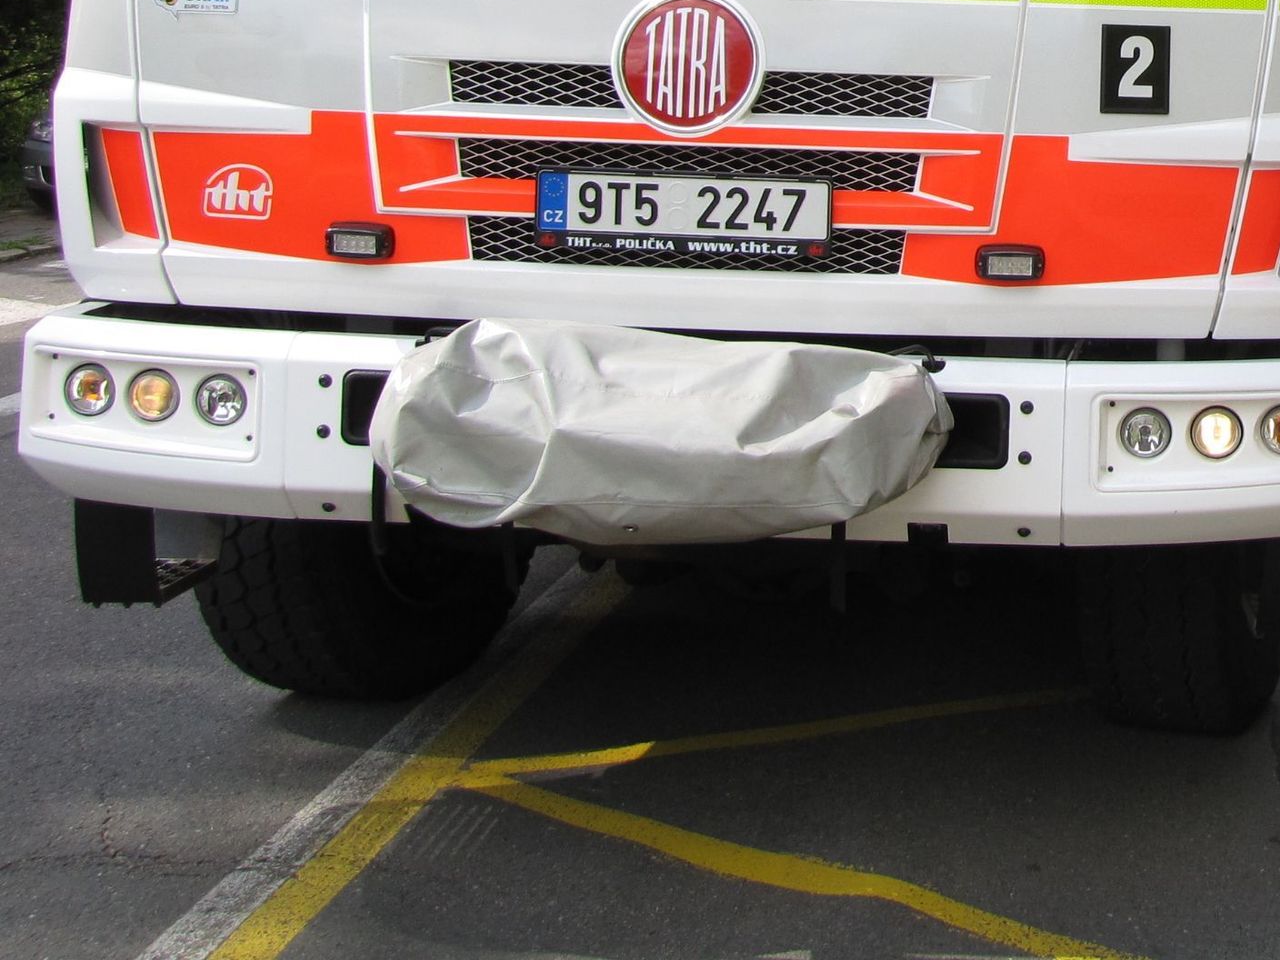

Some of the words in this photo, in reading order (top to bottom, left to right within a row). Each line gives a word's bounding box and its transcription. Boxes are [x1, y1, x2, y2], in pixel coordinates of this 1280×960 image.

[645, 6, 727, 119] TATRA
[1117, 34, 1155, 98] 2
[205, 170, 271, 214] tht
[543, 209, 564, 223] CZ
[578, 180, 660, 227] 9T5
[696, 185, 807, 232] 2247
[615, 237, 676, 251] POLIČKA
[687, 239, 798, 256] www.tht.cz
